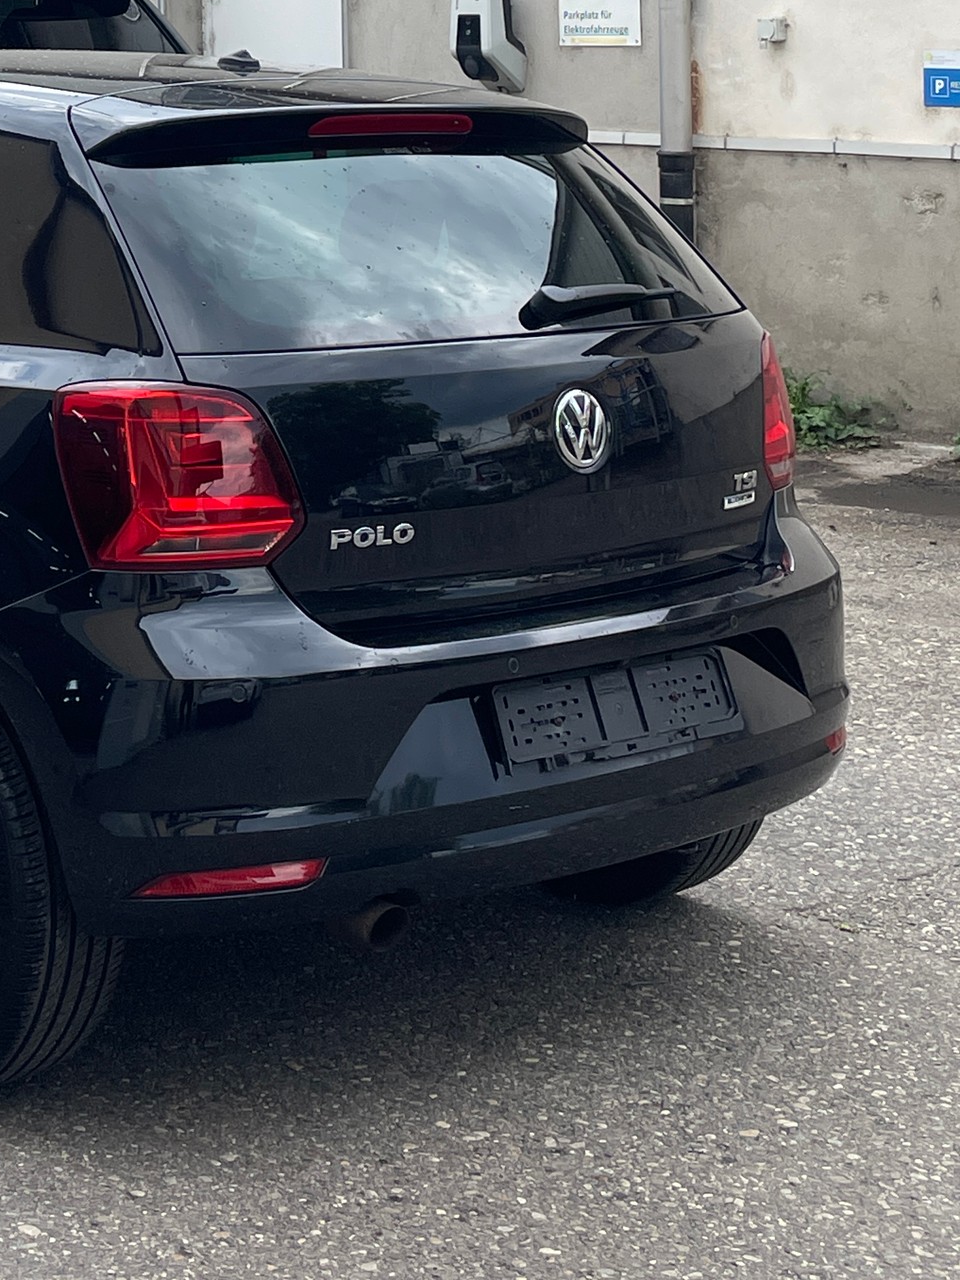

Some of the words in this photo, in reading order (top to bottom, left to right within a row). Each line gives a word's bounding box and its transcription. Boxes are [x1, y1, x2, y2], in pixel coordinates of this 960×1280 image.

[563, 10, 599, 21] Parkplatz
[600, 10, 612, 19] für
[564, 24, 629, 35] Elektrofahrzeuge
[935, 79, 944, 94] P
[330, 523, 415, 550] POLO
